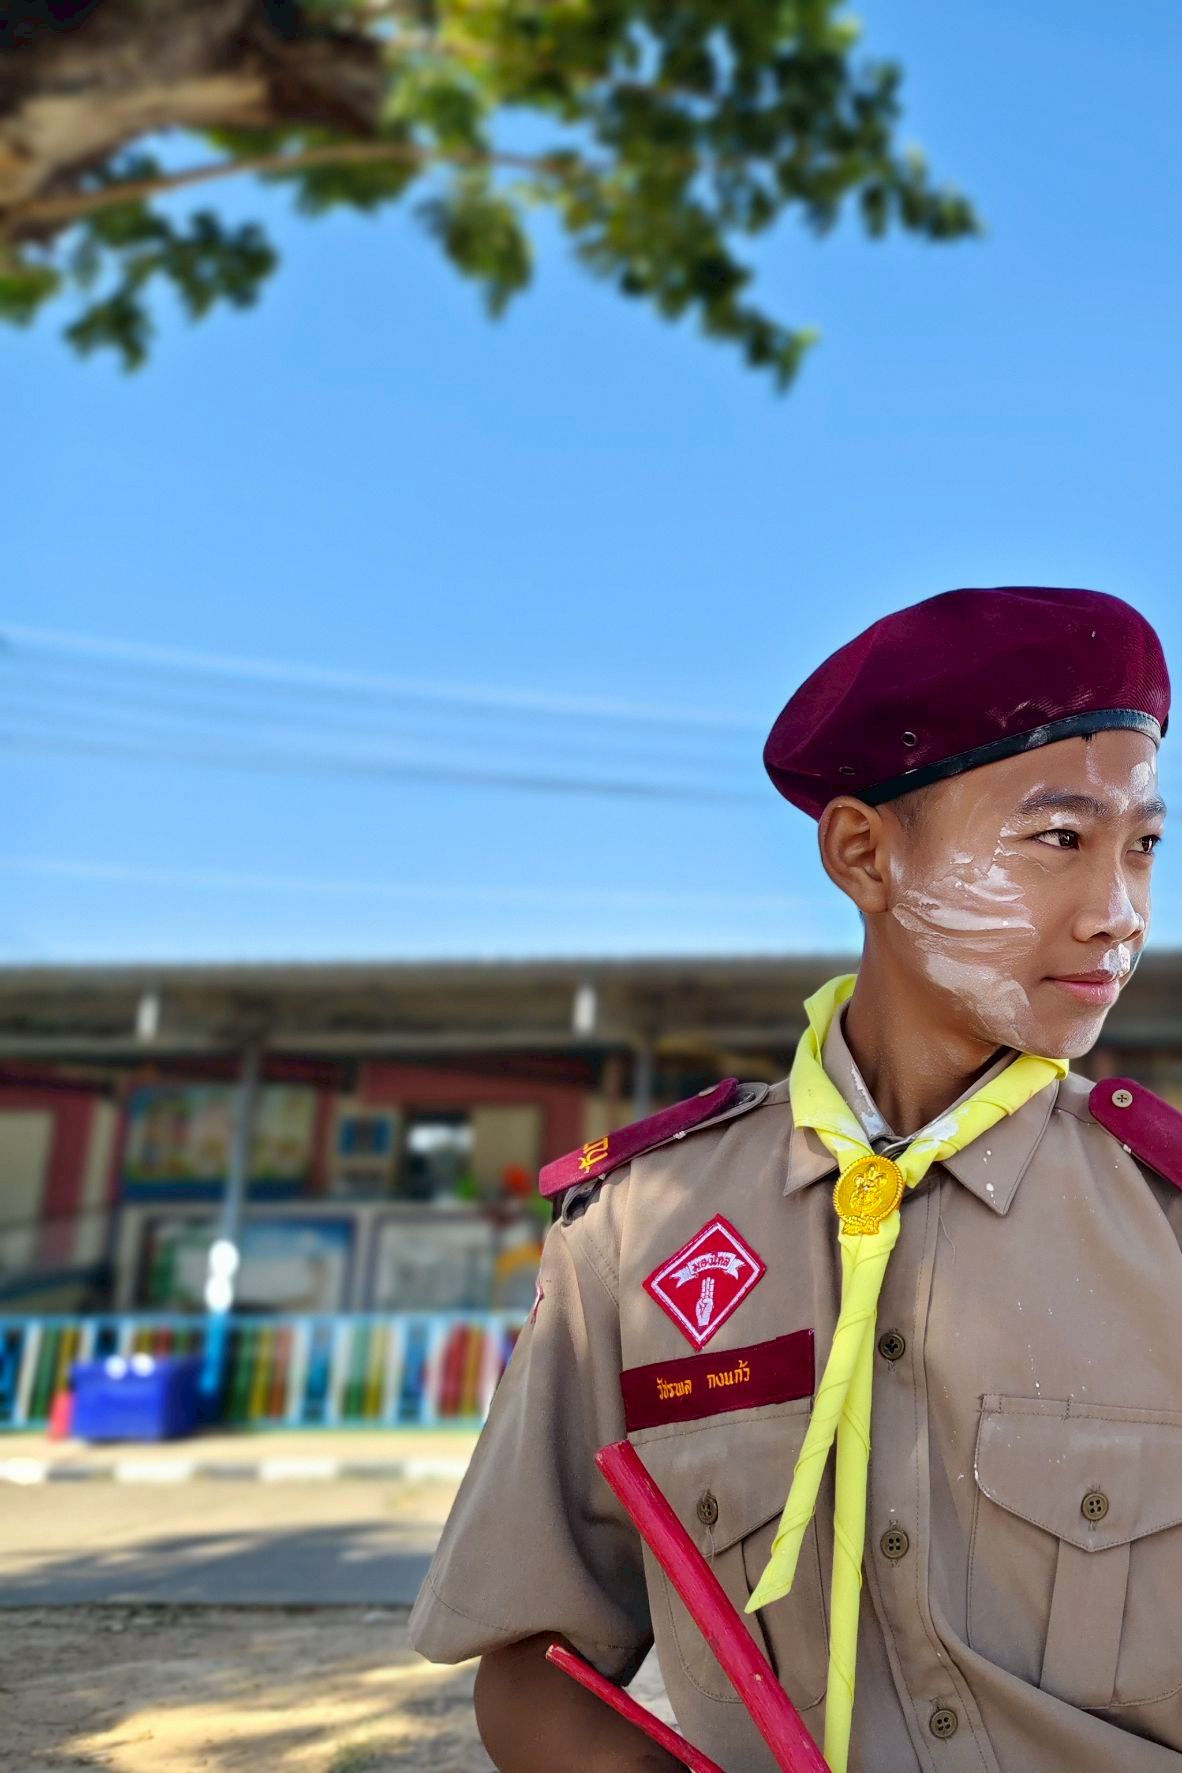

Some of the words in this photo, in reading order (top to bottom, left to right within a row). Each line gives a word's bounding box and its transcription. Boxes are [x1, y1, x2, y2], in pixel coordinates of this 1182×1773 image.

[656, 1377, 692, 1400] วัชรพล
[706, 1359, 750, 1389] กงแก้ว
